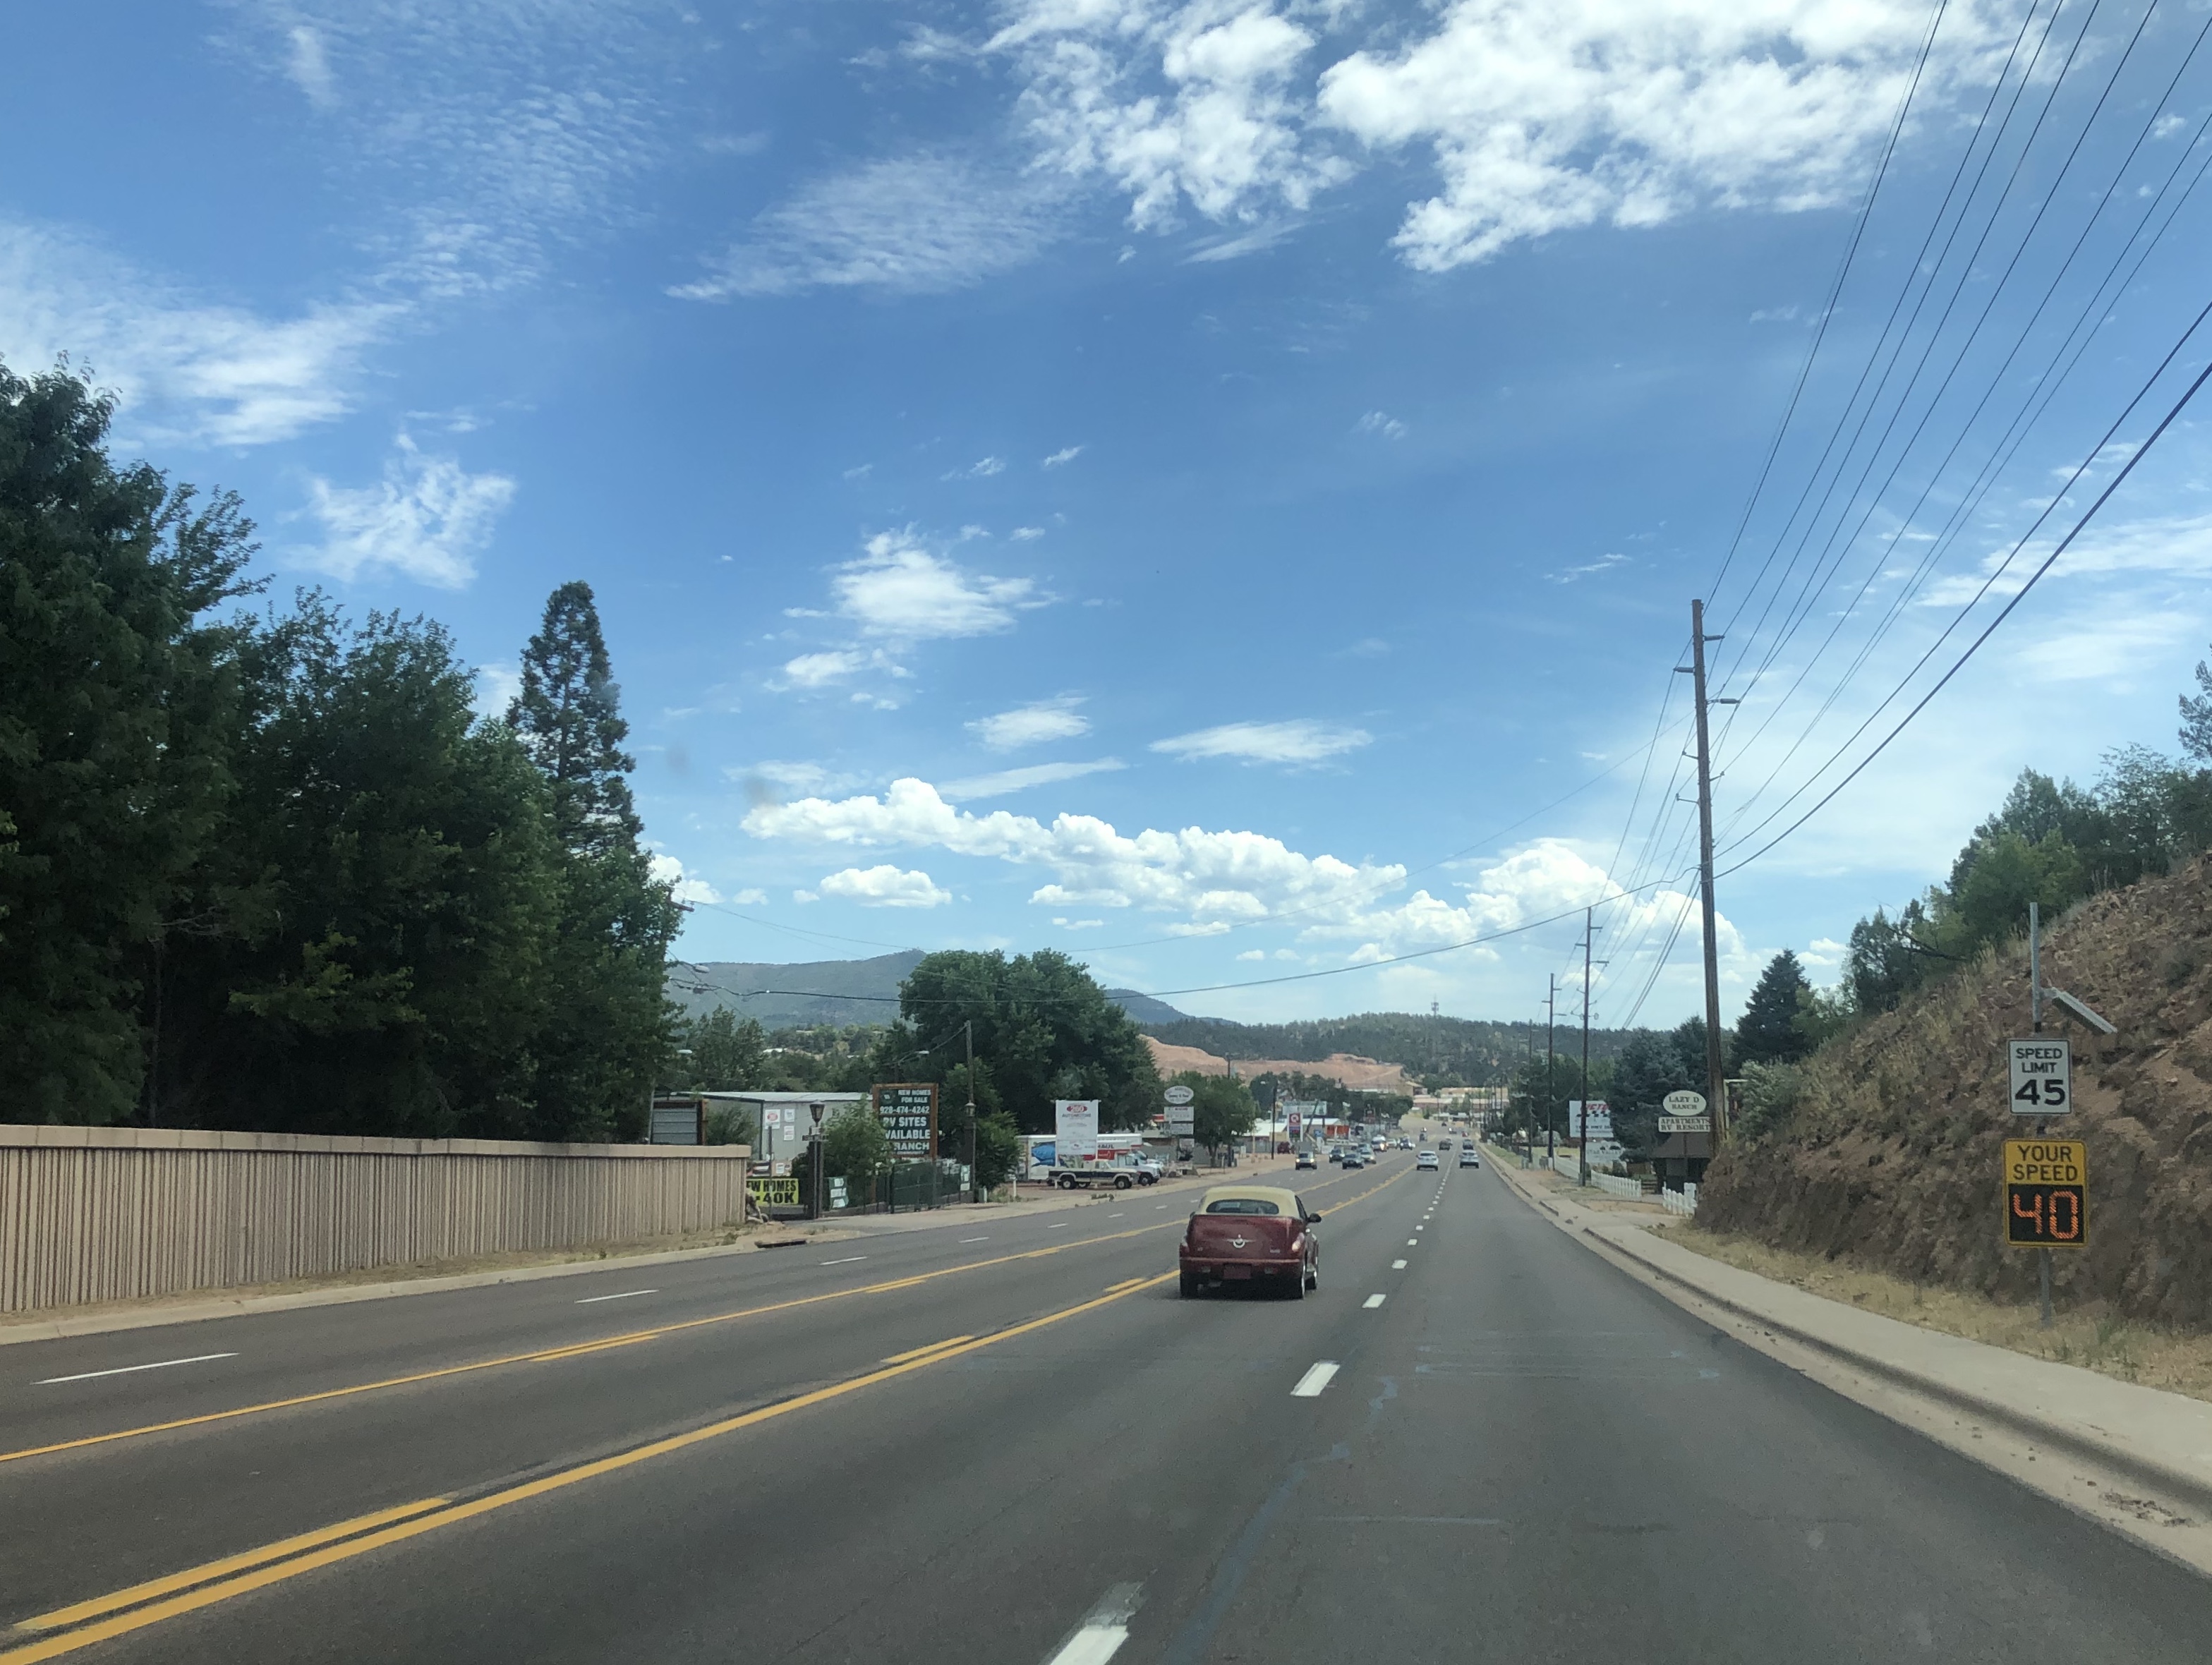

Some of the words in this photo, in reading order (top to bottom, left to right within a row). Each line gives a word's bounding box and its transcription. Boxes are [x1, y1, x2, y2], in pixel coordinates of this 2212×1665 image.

[2015, 1048, 2063, 1060] SPEED
[2021, 1062, 2057, 1074] LIMIT
[2014, 1079, 2066, 1106] 45
[879, 1106, 930, 1114] 928-474-4242
[883, 1117, 896, 1127] RV
[898, 1116, 927, 1127] SITES
[885, 1130, 931, 1139] VAILABLE
[2017, 1145, 2072, 1163] YOUR
[2013, 1165, 2078, 1181] SPEED
[746, 1180, 761, 1192] EW
[763, 1180, 797, 1192] HOMES
[2013, 1190, 2079, 1240] 40
